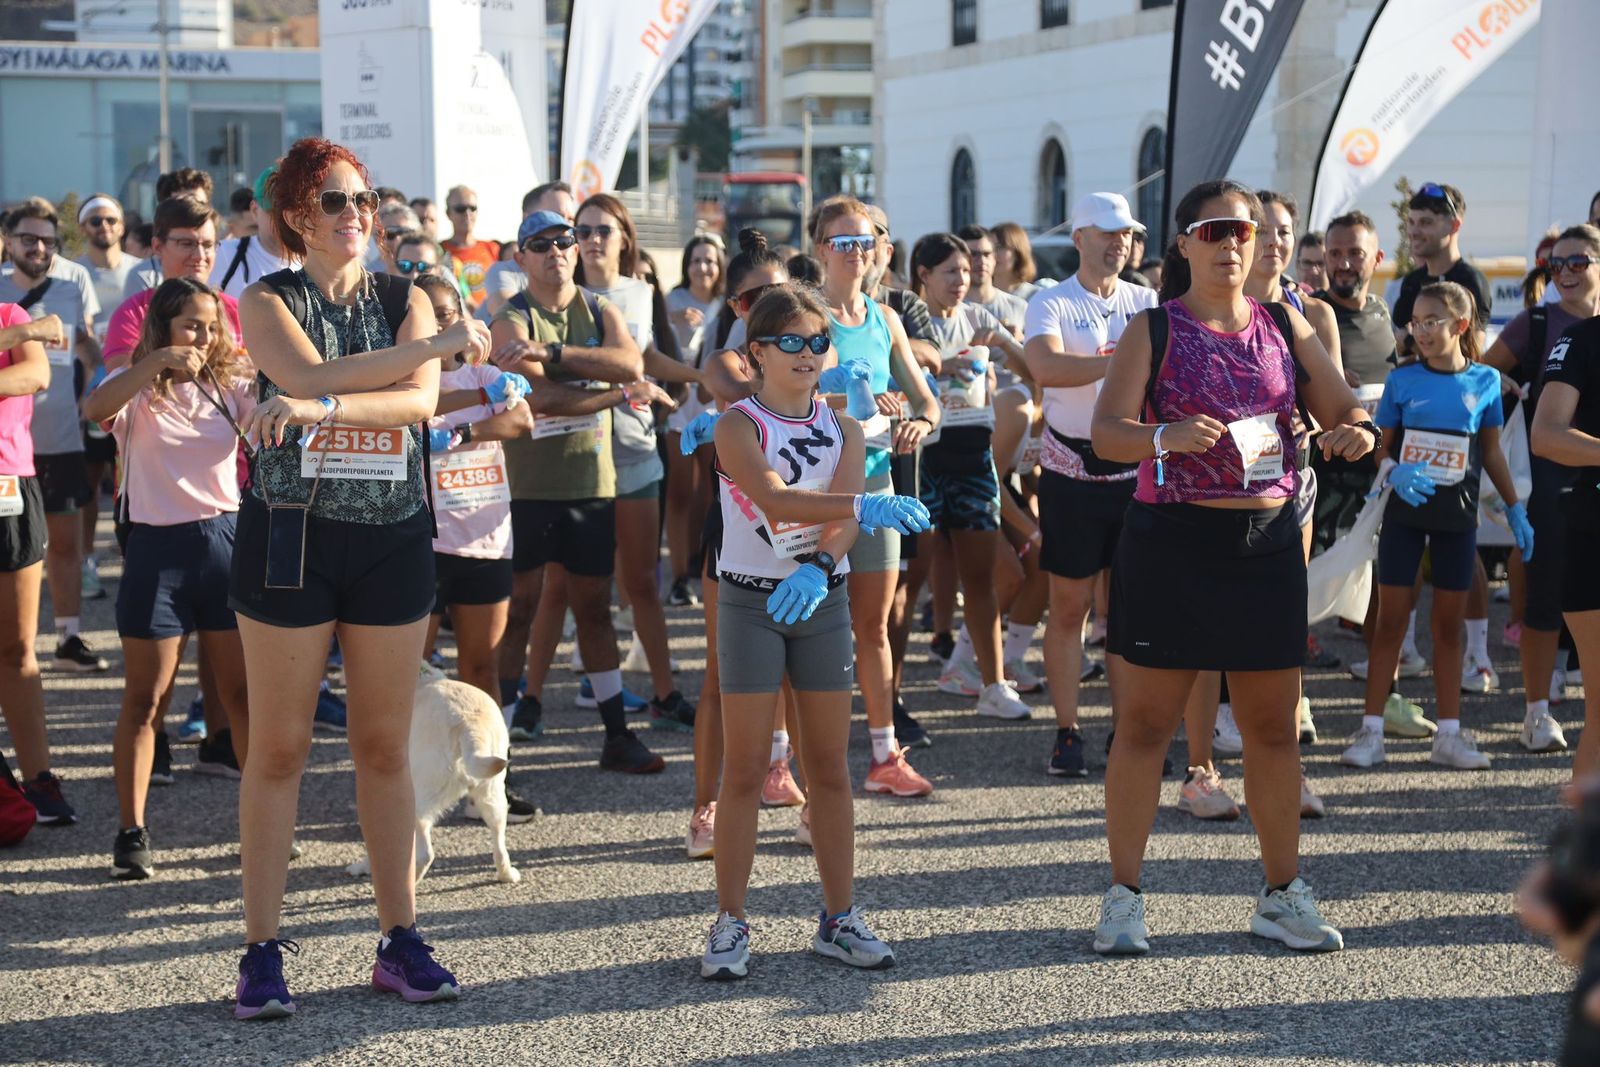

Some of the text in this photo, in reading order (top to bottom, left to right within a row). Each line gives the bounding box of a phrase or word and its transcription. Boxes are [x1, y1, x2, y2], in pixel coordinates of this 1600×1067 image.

[1204, 0, 1276, 91] #B
[317, 430, 393, 452] 25136
[1407, 446, 1460, 468] 27742
[441, 467, 499, 489] 24386
[724, 571, 774, 591] NIKE
